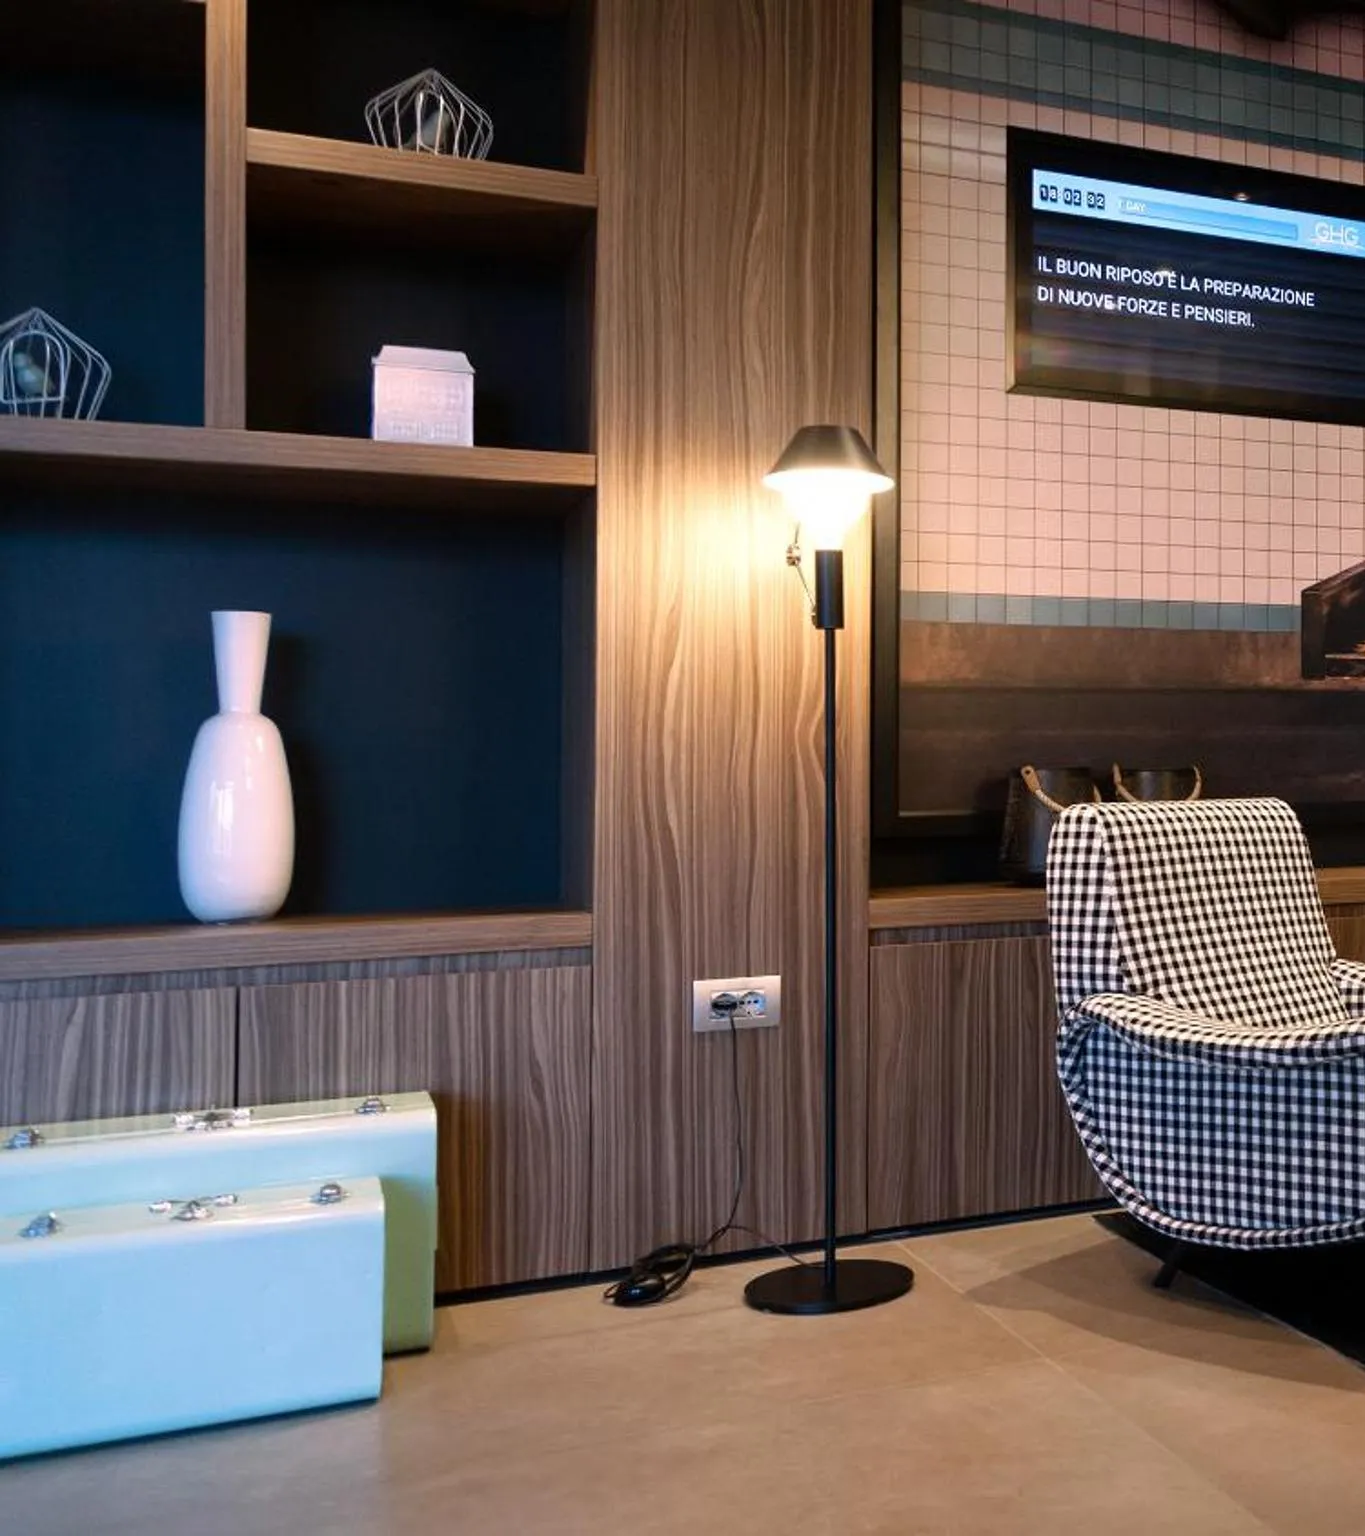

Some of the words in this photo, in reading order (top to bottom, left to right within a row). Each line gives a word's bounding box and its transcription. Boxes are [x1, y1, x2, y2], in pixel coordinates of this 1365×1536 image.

[1315, 222, 1359, 245] GHG
[1038, 256, 1052, 272] IL
[1056, 258, 1102, 279] BUON
[1105, 265, 1163, 287] RIPOSO
[1180, 274, 1200, 292] LA
[1204, 278, 1315, 307] PREPARAZIONE
[1037, 286, 1053, 303] DI
[1059, 289, 1114, 310] NUOVE
[1117, 296, 1167, 316] FORZE
[1171, 303, 1180, 318] E
[1184, 305, 1255, 328] PENSIERI.
